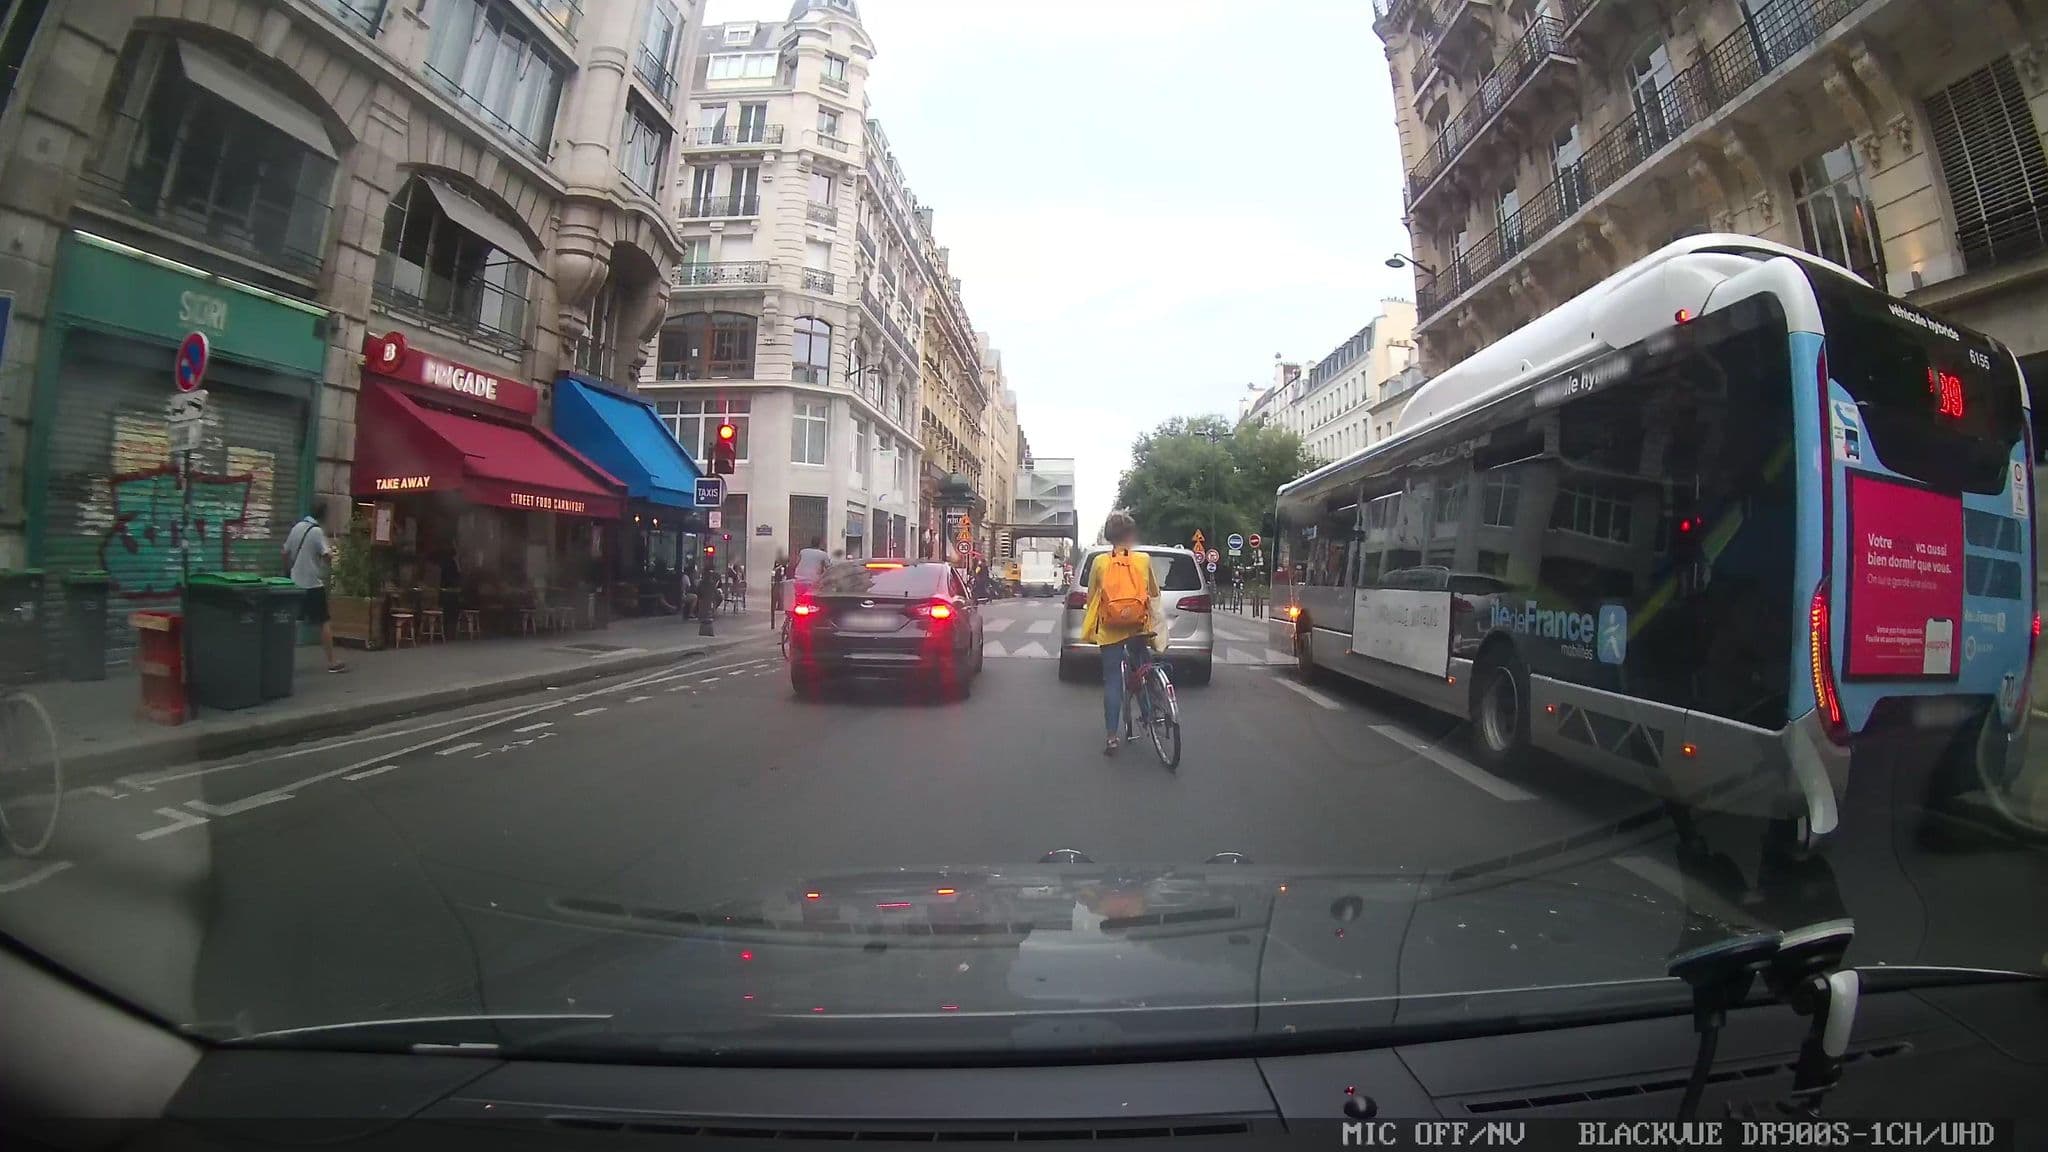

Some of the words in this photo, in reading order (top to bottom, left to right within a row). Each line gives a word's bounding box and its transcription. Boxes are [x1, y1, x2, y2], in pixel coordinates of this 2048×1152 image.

[383, 342, 396, 361] B
[1969, 348, 1990, 370] 6155
[376, 478, 399, 490] TAKE
[400, 476, 430, 489] AWAY
[698, 488, 718, 497] TAXIS
[511, 493, 534, 507] STREET
[536, 496, 552, 509] FOOD
[1868, 533, 1893, 549] Votre
[1915, 543, 1926, 554] va
[1927, 544, 1948, 557] aussi
[1867, 551, 1888, 566] bien
[1888, 554, 1917, 569] dormir
[1917, 560, 1932, 575] que
[1932, 561, 1952, 574] vous.
